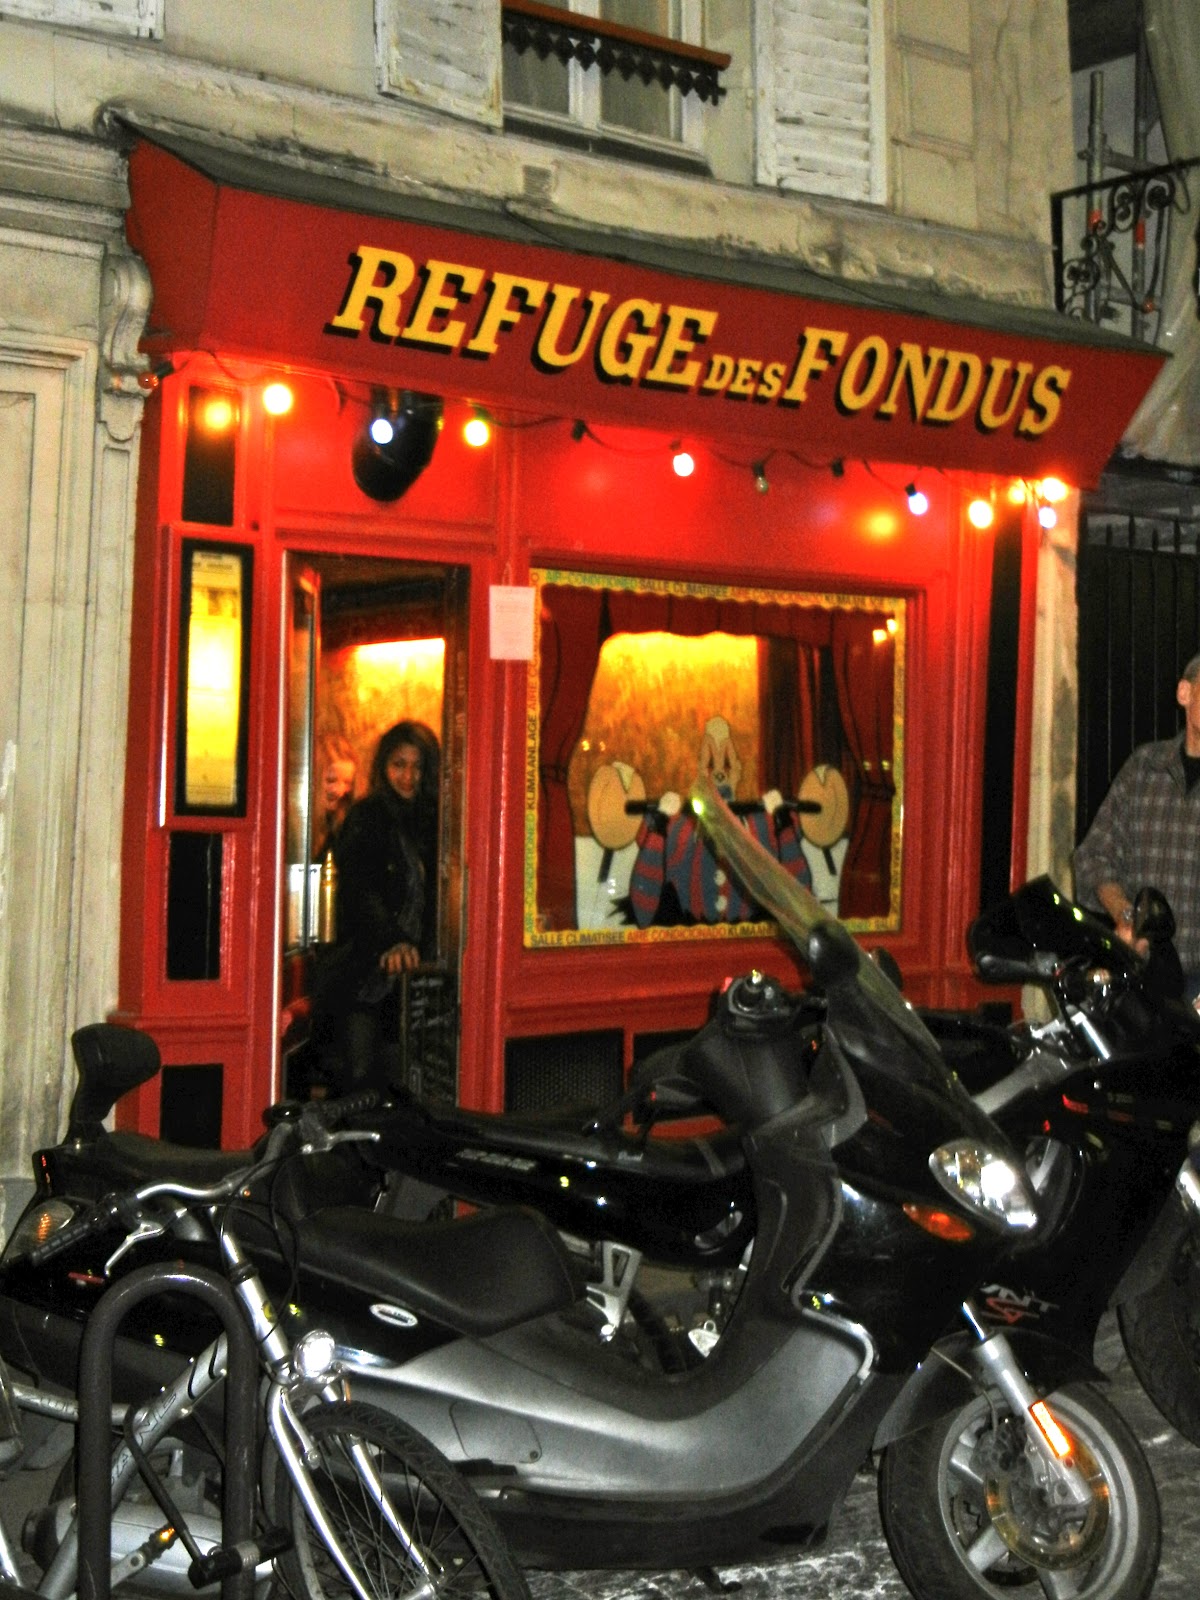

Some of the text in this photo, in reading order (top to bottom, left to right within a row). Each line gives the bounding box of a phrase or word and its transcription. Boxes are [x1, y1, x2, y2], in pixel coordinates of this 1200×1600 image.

[327, 245, 1073, 436] REFUGE DES FONDUS
[531, 931, 564, 947] SALLE
